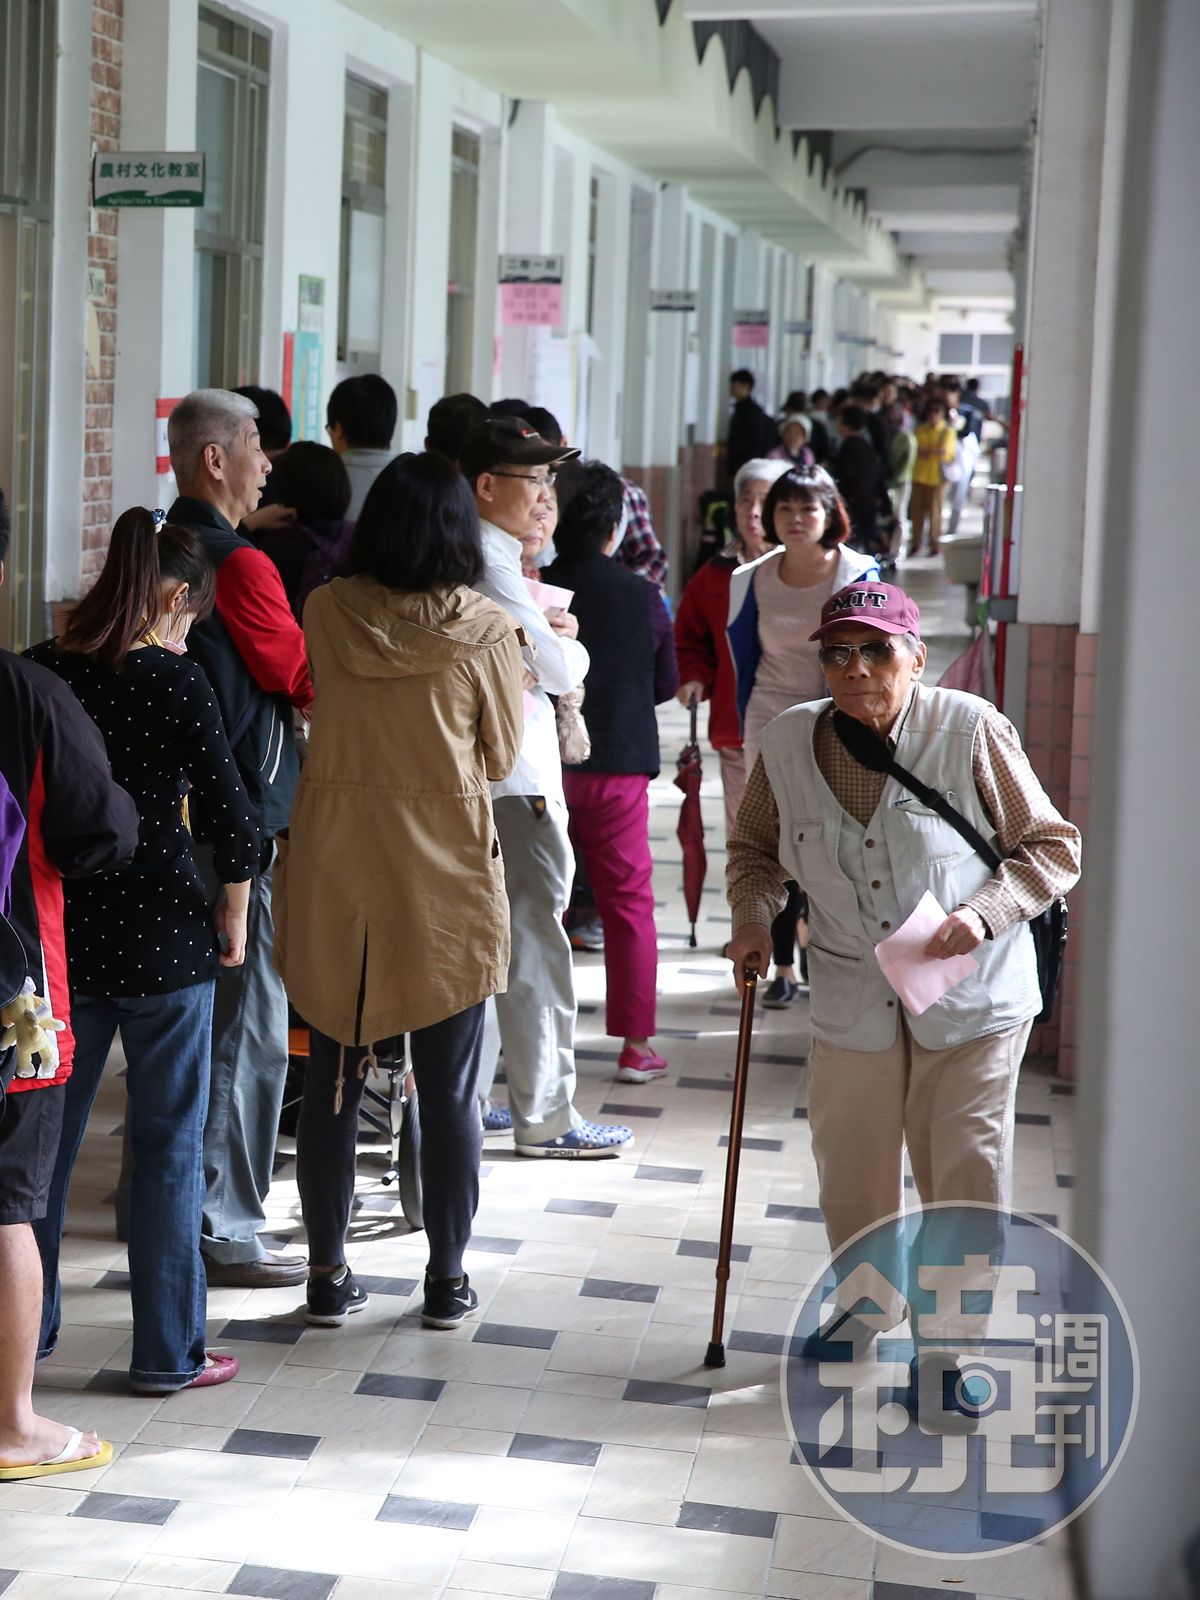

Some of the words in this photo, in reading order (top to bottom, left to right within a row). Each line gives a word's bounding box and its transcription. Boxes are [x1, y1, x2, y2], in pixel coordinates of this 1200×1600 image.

[99, 162, 200, 178] 農村文化教室
[829, 590, 888, 615] MIT
[544, 1150, 581, 1158] SPORT
